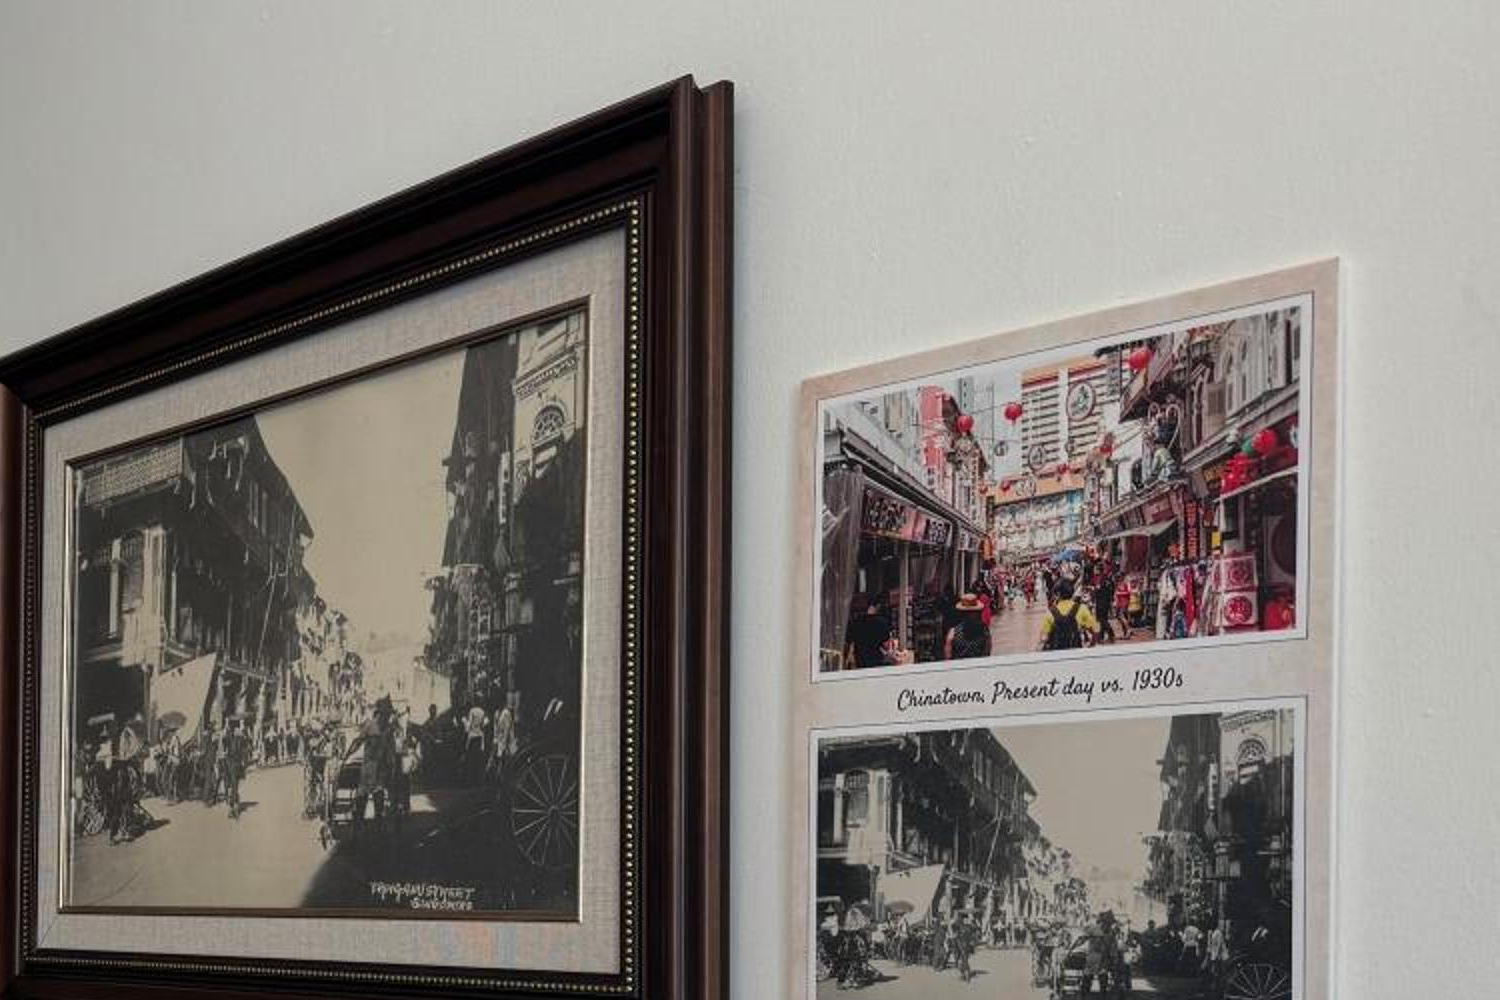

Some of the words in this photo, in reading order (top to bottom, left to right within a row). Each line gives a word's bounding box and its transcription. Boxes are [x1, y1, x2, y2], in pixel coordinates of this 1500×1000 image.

[897, 687, 985, 711] Chinatown,
[991, 678, 1060, 704] Present
[1062, 676, 1095, 704] day
[1101, 679, 1124, 693] vs.
[1132, 667, 1184, 691] 1930s
